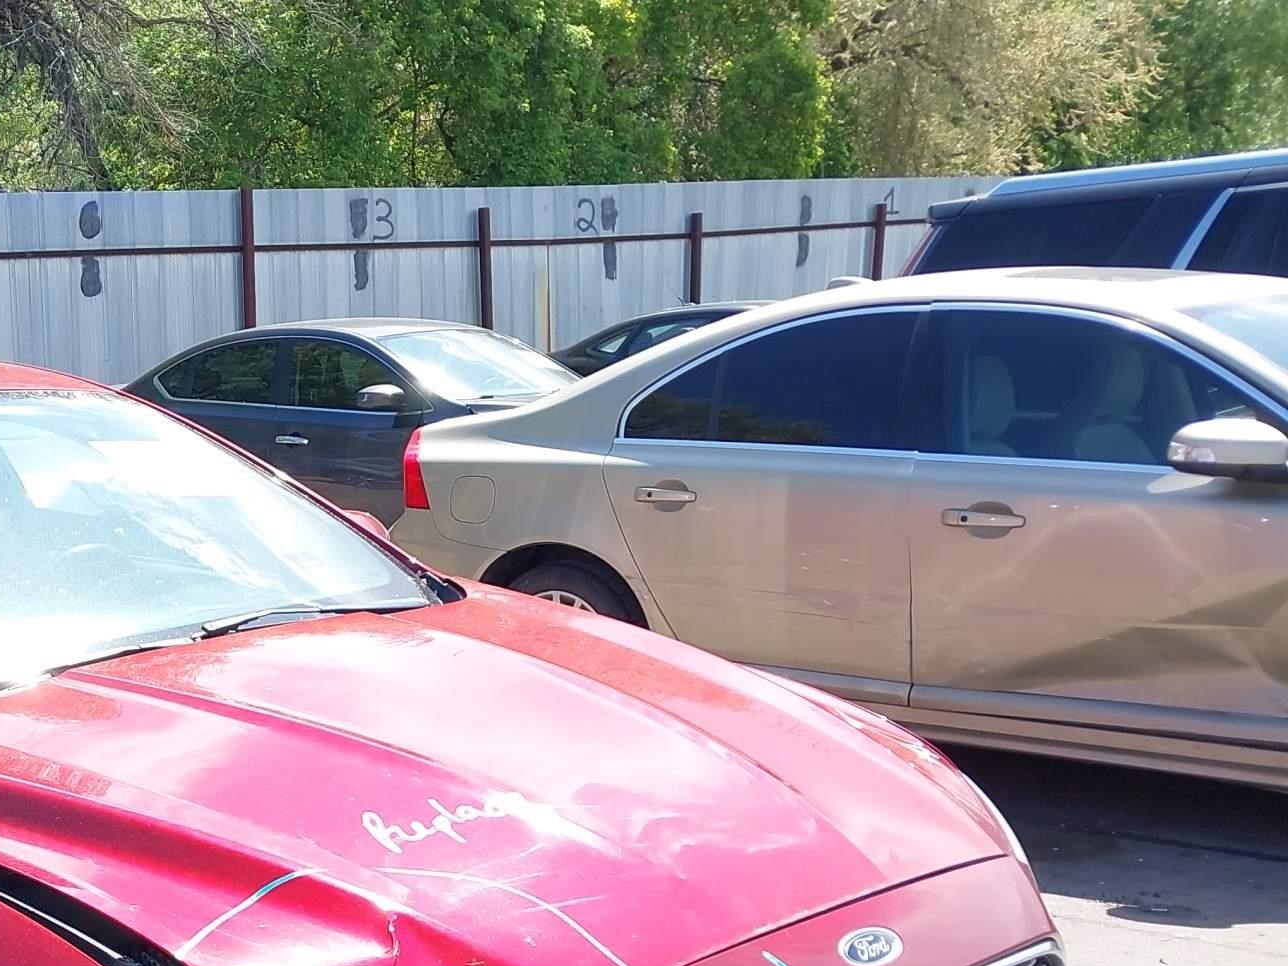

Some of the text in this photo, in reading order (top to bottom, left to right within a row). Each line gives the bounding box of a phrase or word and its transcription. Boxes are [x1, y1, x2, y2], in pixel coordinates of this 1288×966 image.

[373, 199, 394, 240] 3
[575, 199, 598, 235] 2
[852, 933, 891, 961] Ford
